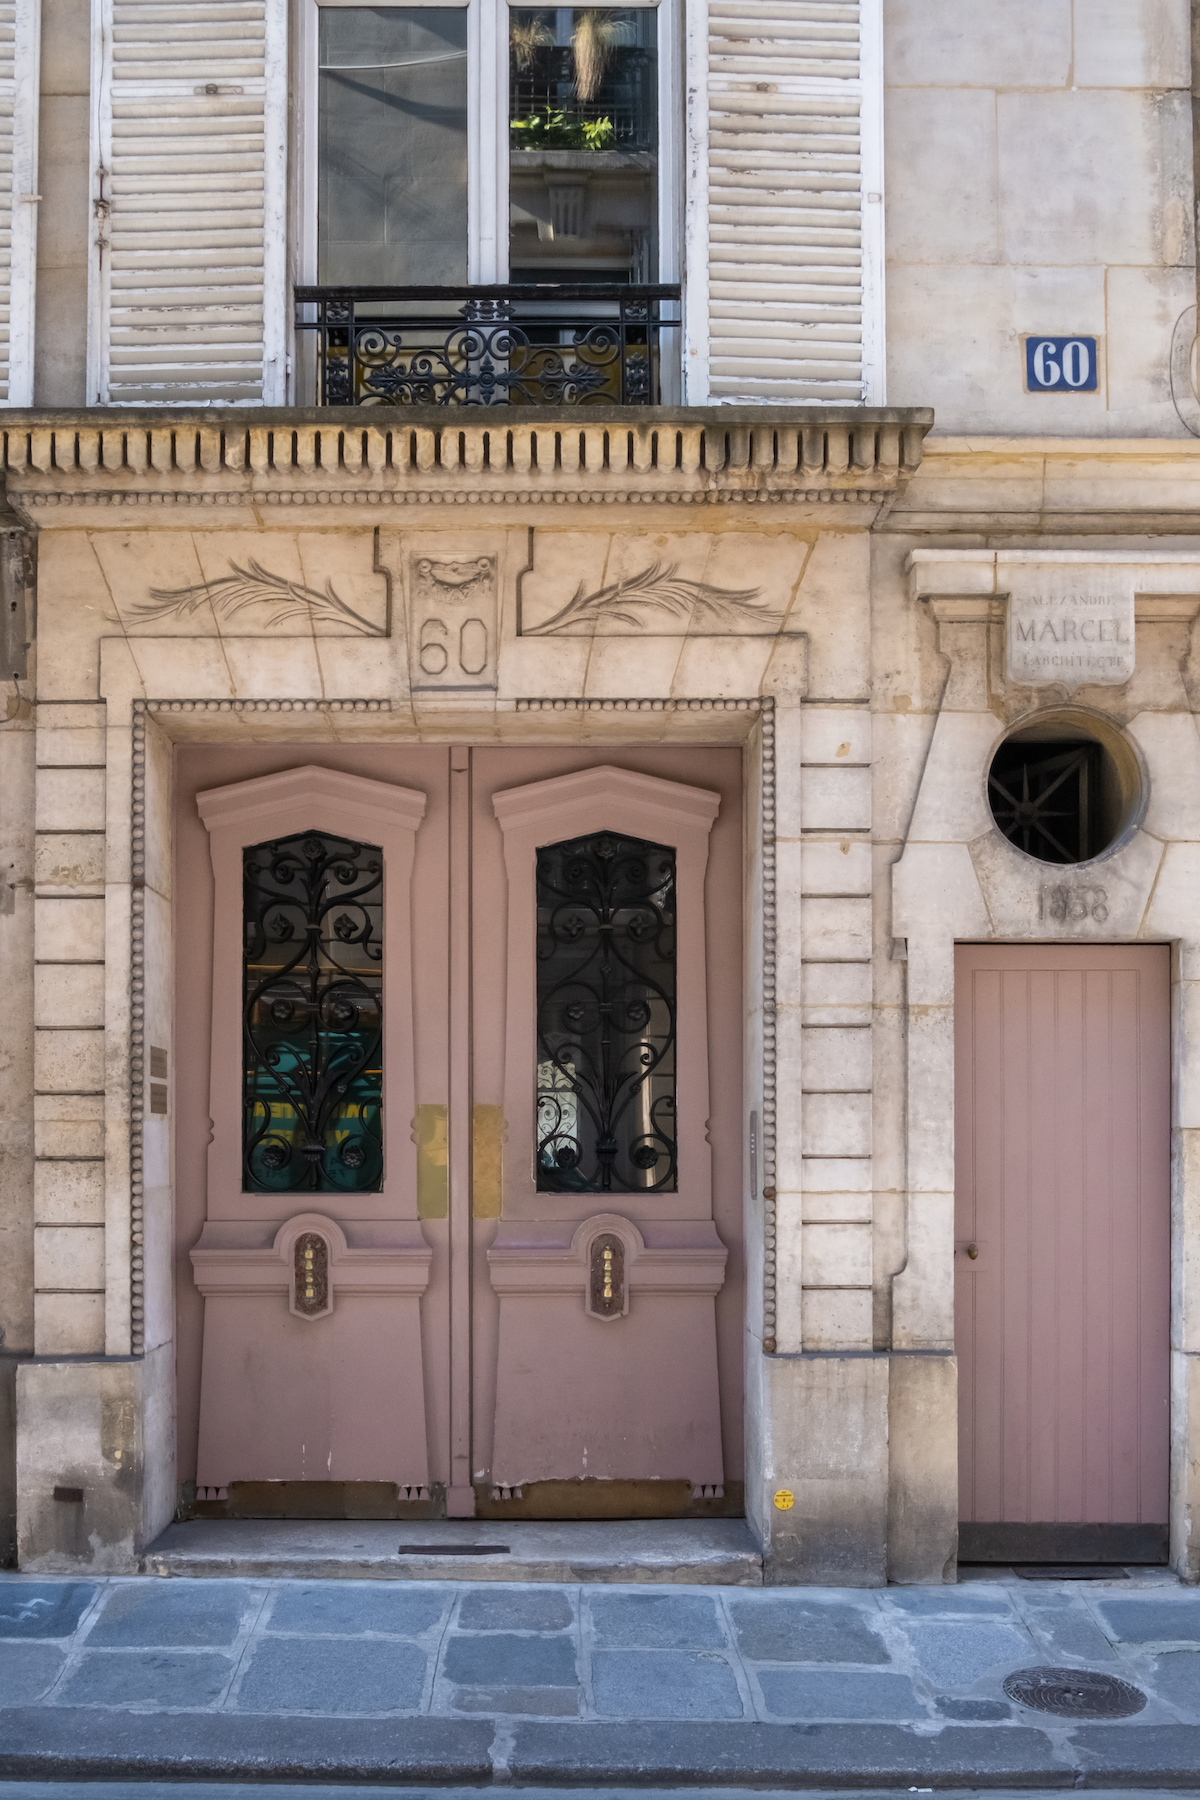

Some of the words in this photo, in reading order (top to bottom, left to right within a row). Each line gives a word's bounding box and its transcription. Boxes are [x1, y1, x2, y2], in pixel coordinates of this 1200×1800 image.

[1034, 341, 1089, 387] 60
[419, 618, 487, 675] 60
[1016, 618, 1129, 642] MARCEL
